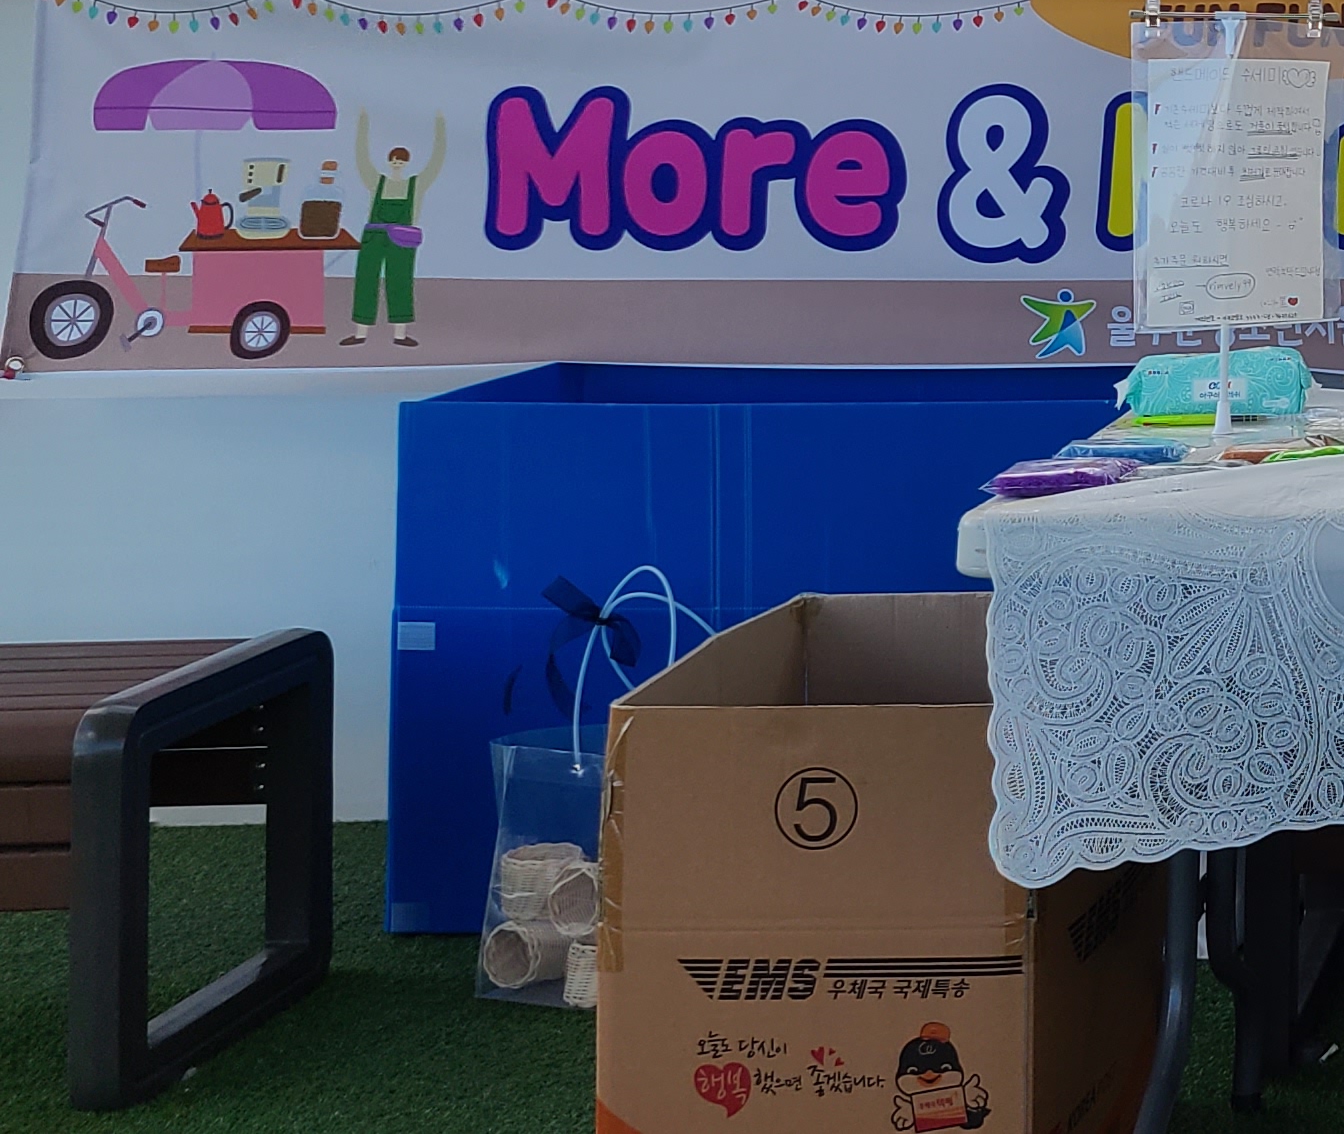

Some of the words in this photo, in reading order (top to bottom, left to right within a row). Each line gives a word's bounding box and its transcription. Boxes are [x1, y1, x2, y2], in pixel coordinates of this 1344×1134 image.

[485, 85, 907, 252] More
[936, 82, 1070, 264] &
[1180, 195, 1213, 208] 코로나
[1169, 219, 1204, 234] 오늘도
[718, 958, 821, 1001] EMS
[827, 978, 887, 1000] 우체국
[892, 978, 971, 1000] 국제특송
[697, 1031, 734, 1057] 오늘도
[738, 1036, 788, 1058] 당신이
[697, 1069, 749, 1106] 행복
[753, 1069, 803, 1096] 했으면
